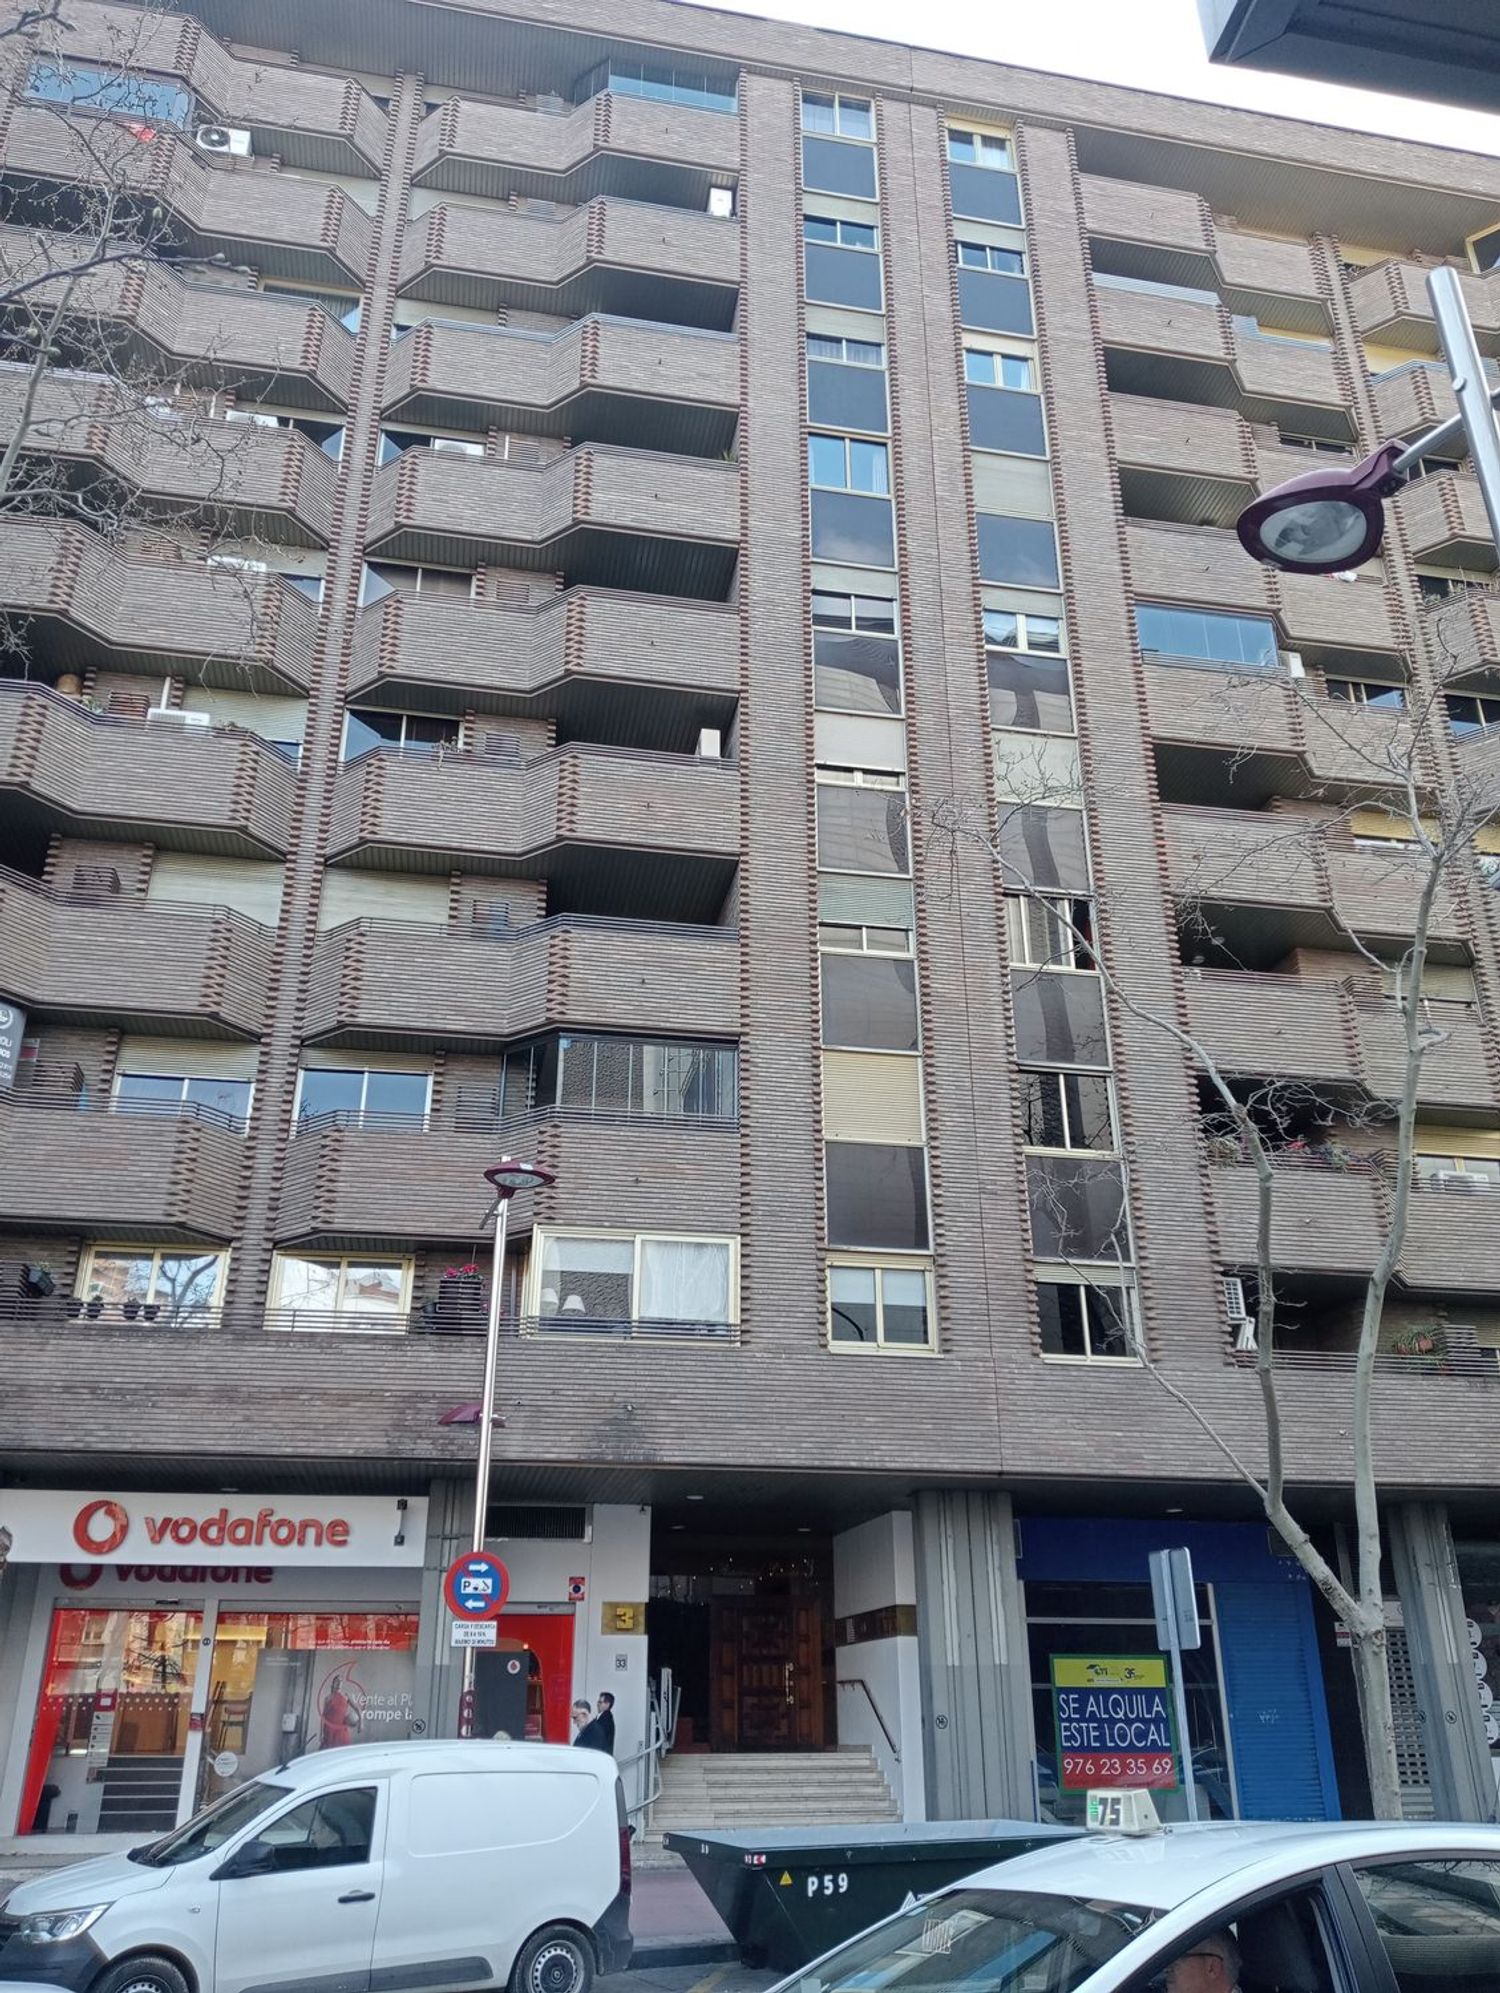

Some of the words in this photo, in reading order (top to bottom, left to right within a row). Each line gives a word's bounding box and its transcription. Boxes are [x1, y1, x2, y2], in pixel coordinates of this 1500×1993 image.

[144, 1508, 350, 1547] vodafone
[616, 1607, 634, 1629] 3
[352, 1693, 385, 1706] Vente
[387, 1693, 398, 1706] al
[1059, 1694, 1080, 1719] SE
[1085, 1694, 1167, 1720] ALQUILA
[361, 1709, 402, 1722] rompe
[1061, 1722, 1101, 1747] ESTE
[1104, 1722, 1171, 1747] LOCAL
[1063, 1758, 1096, 1775] 976
[1099, 1758, 1121, 1775] 23
[1126, 1758, 1147, 1775] 35
[1152, 1758, 1172, 1775] 69
[1098, 1796, 1121, 1827] 75
